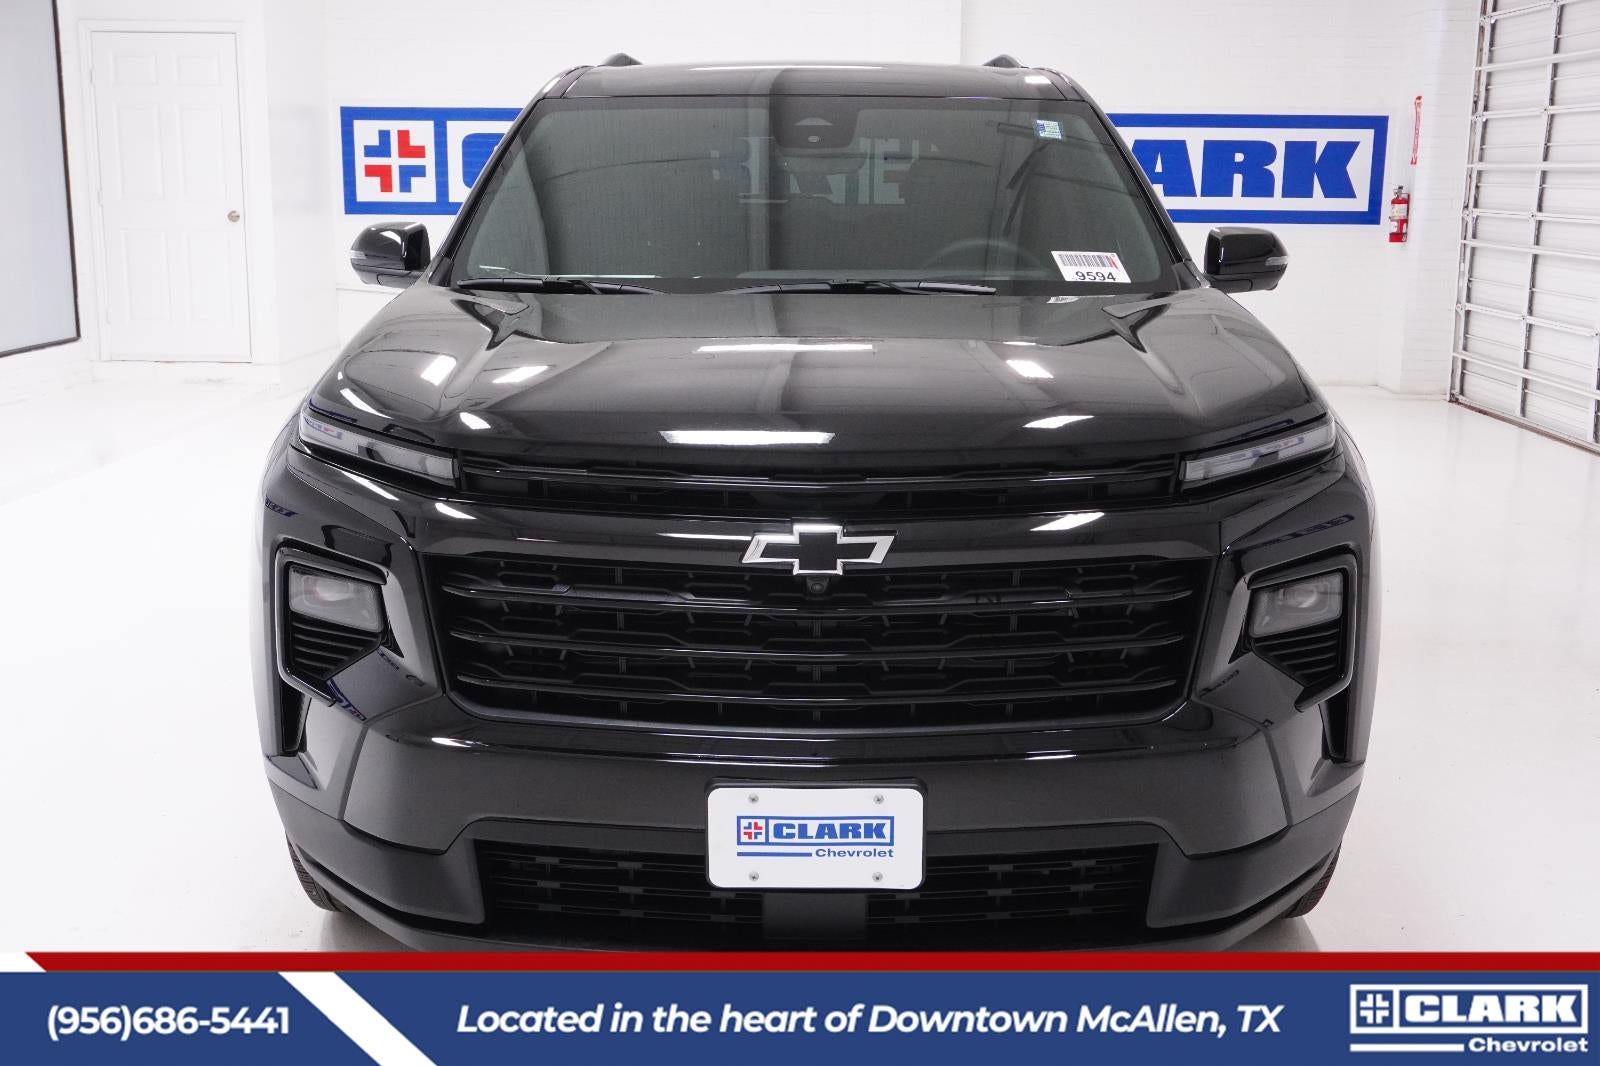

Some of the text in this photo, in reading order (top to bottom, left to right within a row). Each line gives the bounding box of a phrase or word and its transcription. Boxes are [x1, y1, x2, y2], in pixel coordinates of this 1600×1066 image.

[1075, 271, 1116, 281] 9594
[773, 822, 886, 840] CLARK
[815, 848, 894, 858] Chevrolet
